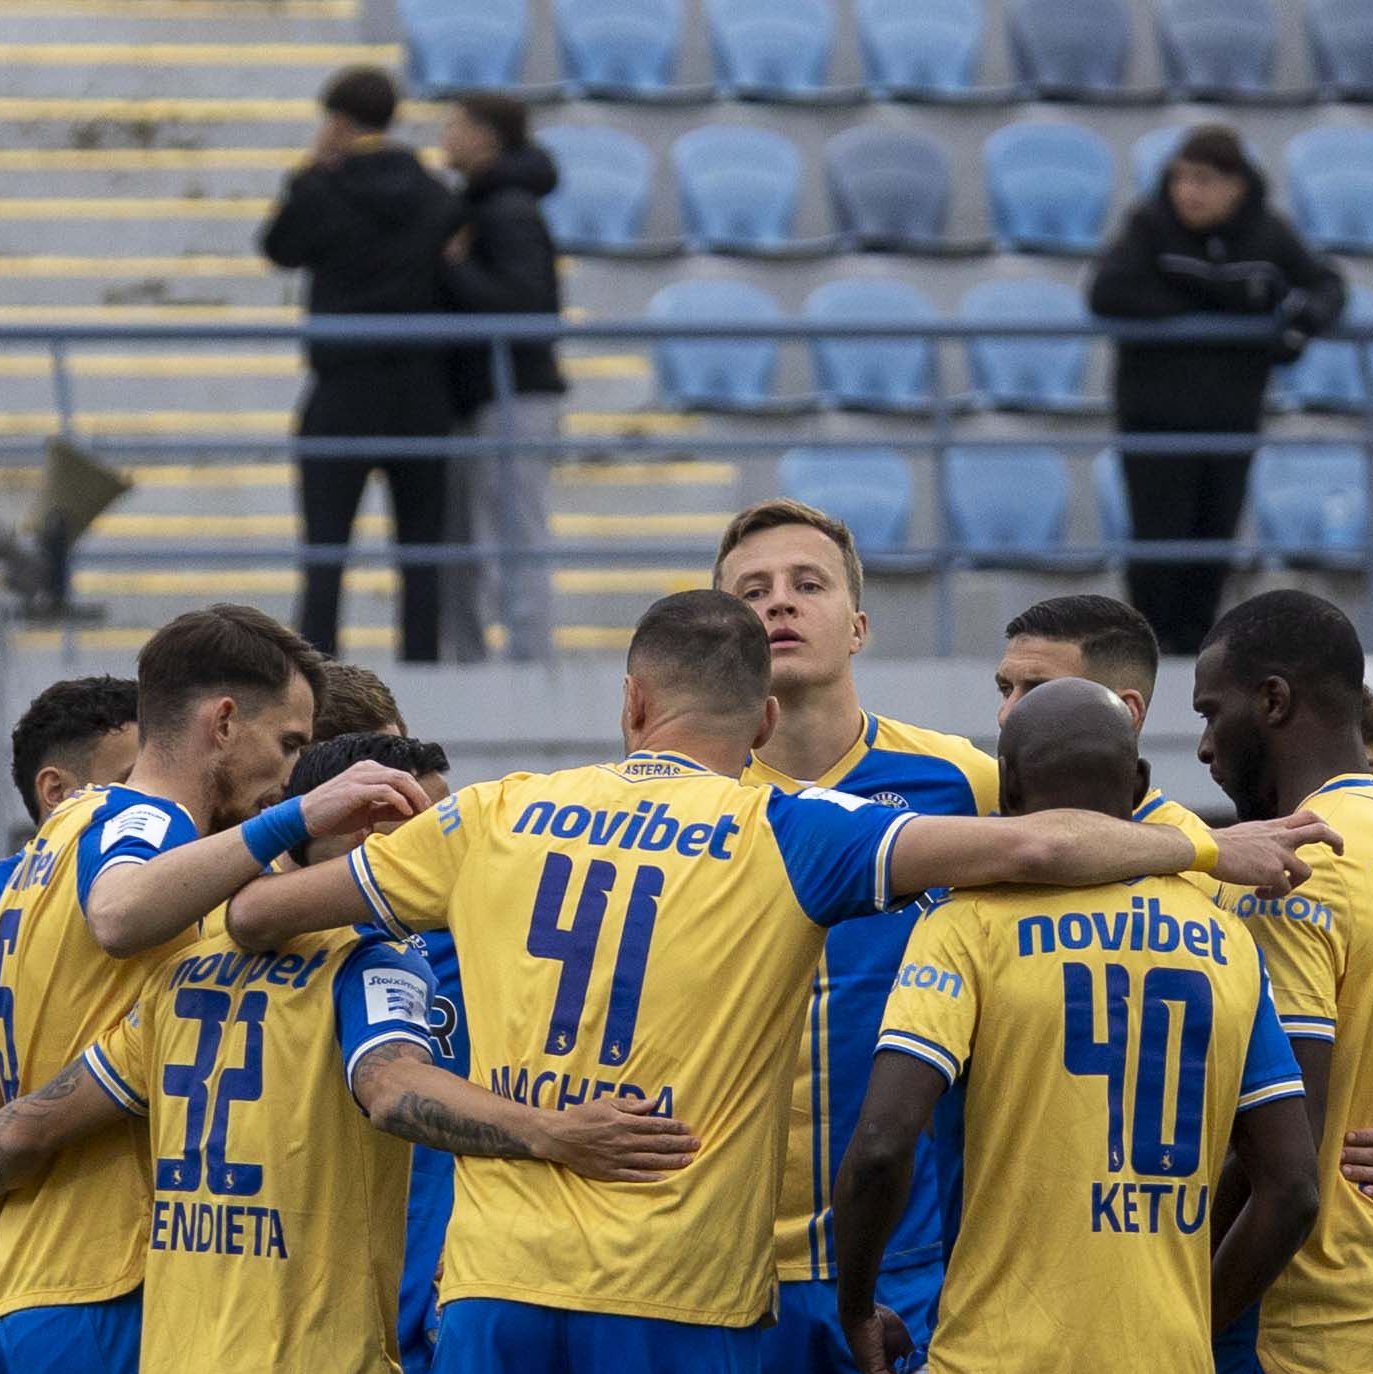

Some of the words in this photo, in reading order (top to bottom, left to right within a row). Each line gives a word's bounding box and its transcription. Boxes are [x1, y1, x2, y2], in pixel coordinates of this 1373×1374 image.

[623, 764, 680, 776] ASTERAS
[512, 801, 740, 860] novibet
[527, 852, 664, 1067] 41
[1018, 896, 1228, 966] novibet
[168, 947, 331, 991] novbet
[155, 987, 269, 1197] 32
[1063, 961, 1214, 1178] 40
[151, 1200, 289, 1260] ENDIETA
[1091, 1182, 1209, 1234] KETU
